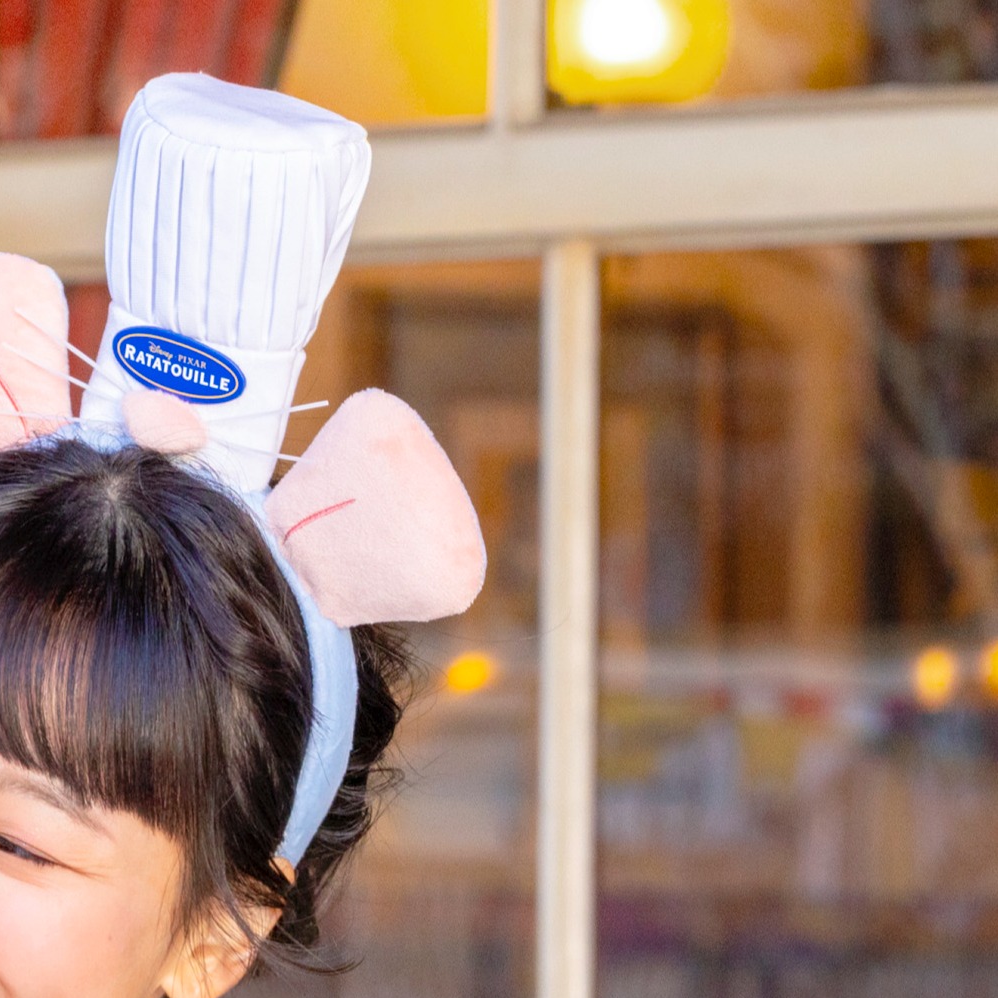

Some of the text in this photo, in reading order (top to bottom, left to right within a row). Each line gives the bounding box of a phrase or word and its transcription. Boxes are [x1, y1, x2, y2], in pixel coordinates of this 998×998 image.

[124, 343, 231, 392] RATATOUILLE
[148, 341, 207, 370] Disney PIXAR
